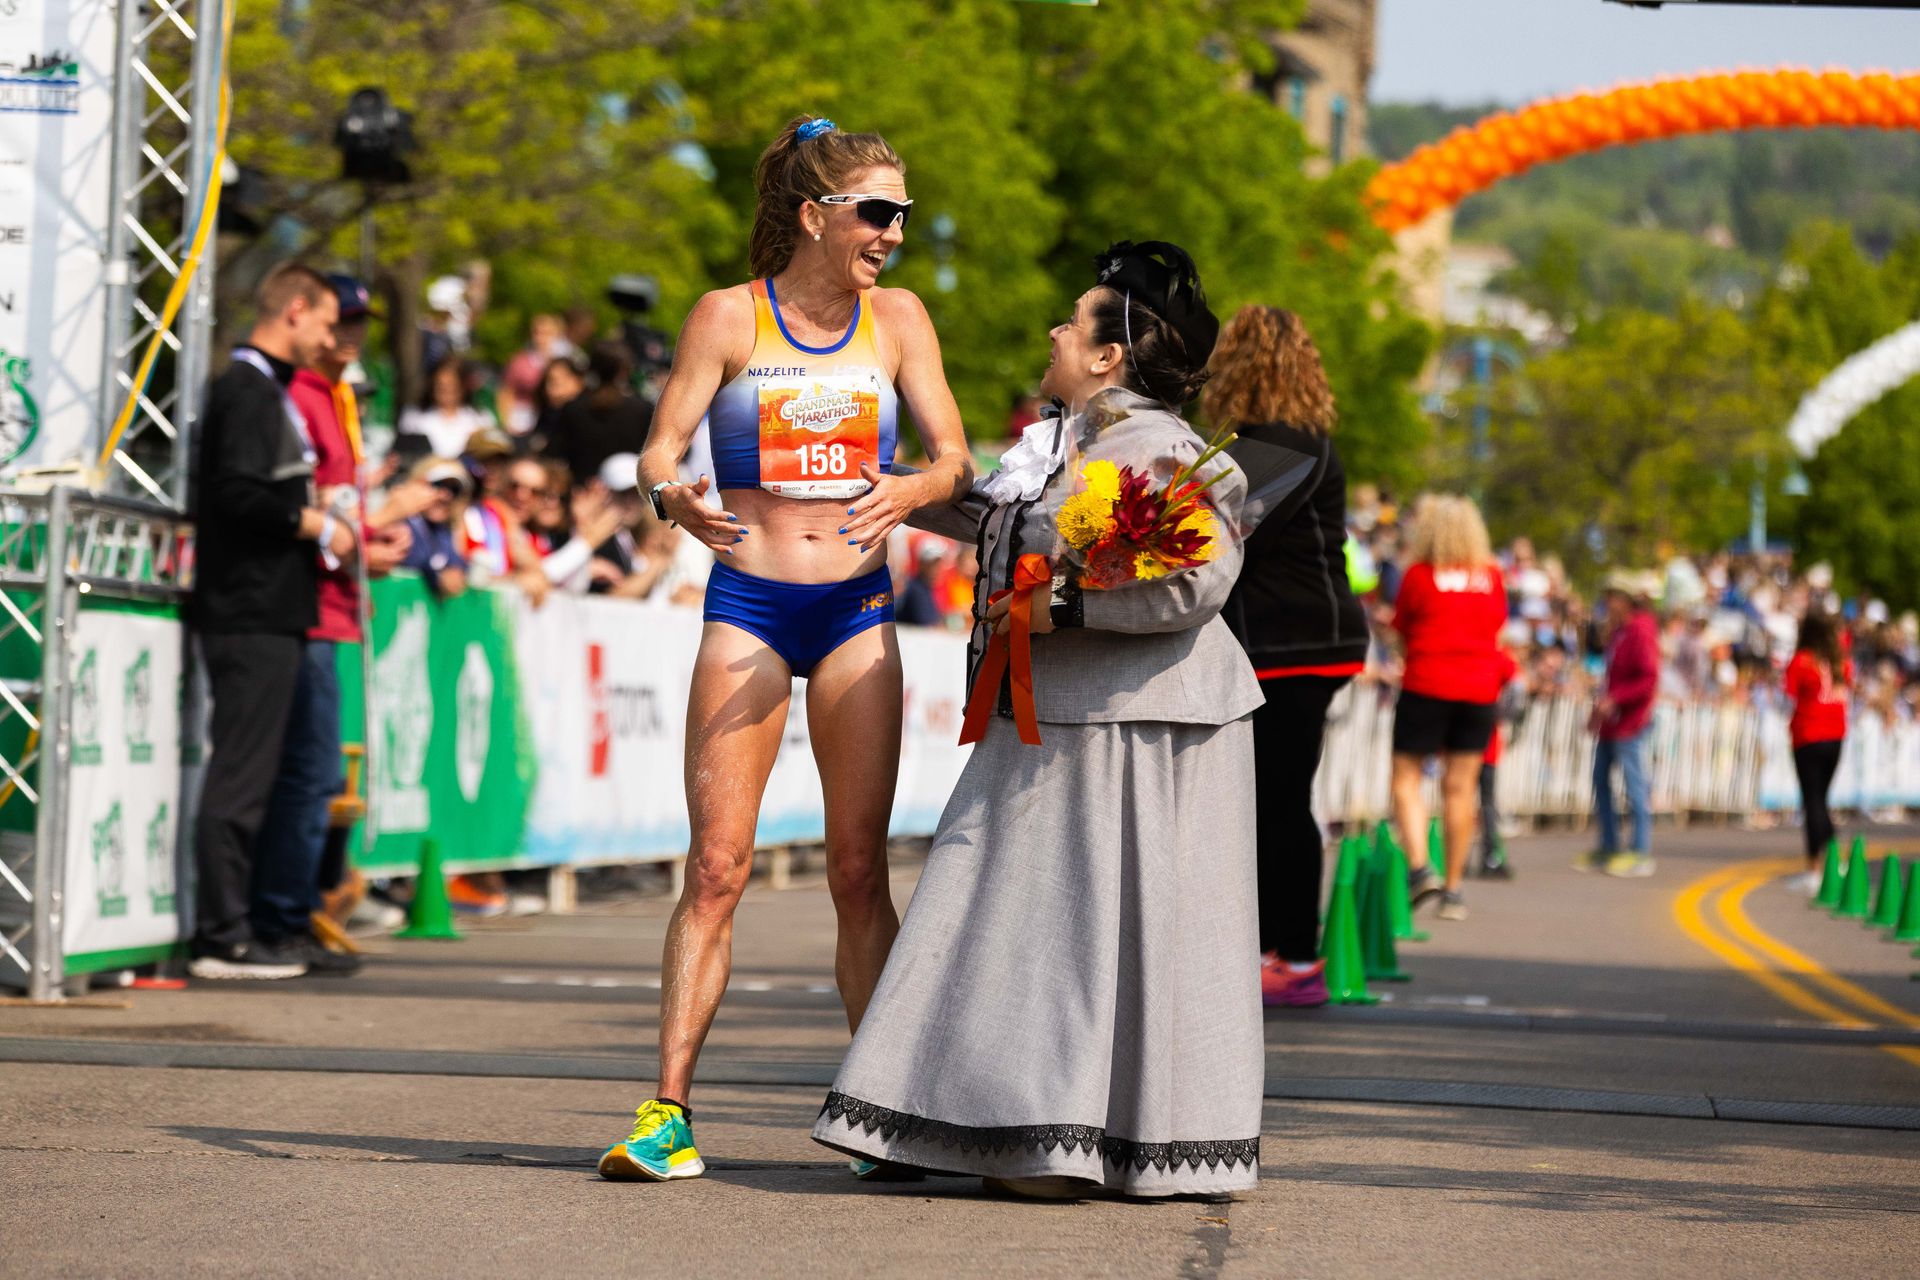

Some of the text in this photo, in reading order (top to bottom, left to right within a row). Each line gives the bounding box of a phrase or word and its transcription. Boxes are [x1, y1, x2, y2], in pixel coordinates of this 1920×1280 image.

[773, 367, 806, 377] ELITE
[794, 404, 858, 427] MARATHON
[796, 443, 847, 475] 158
